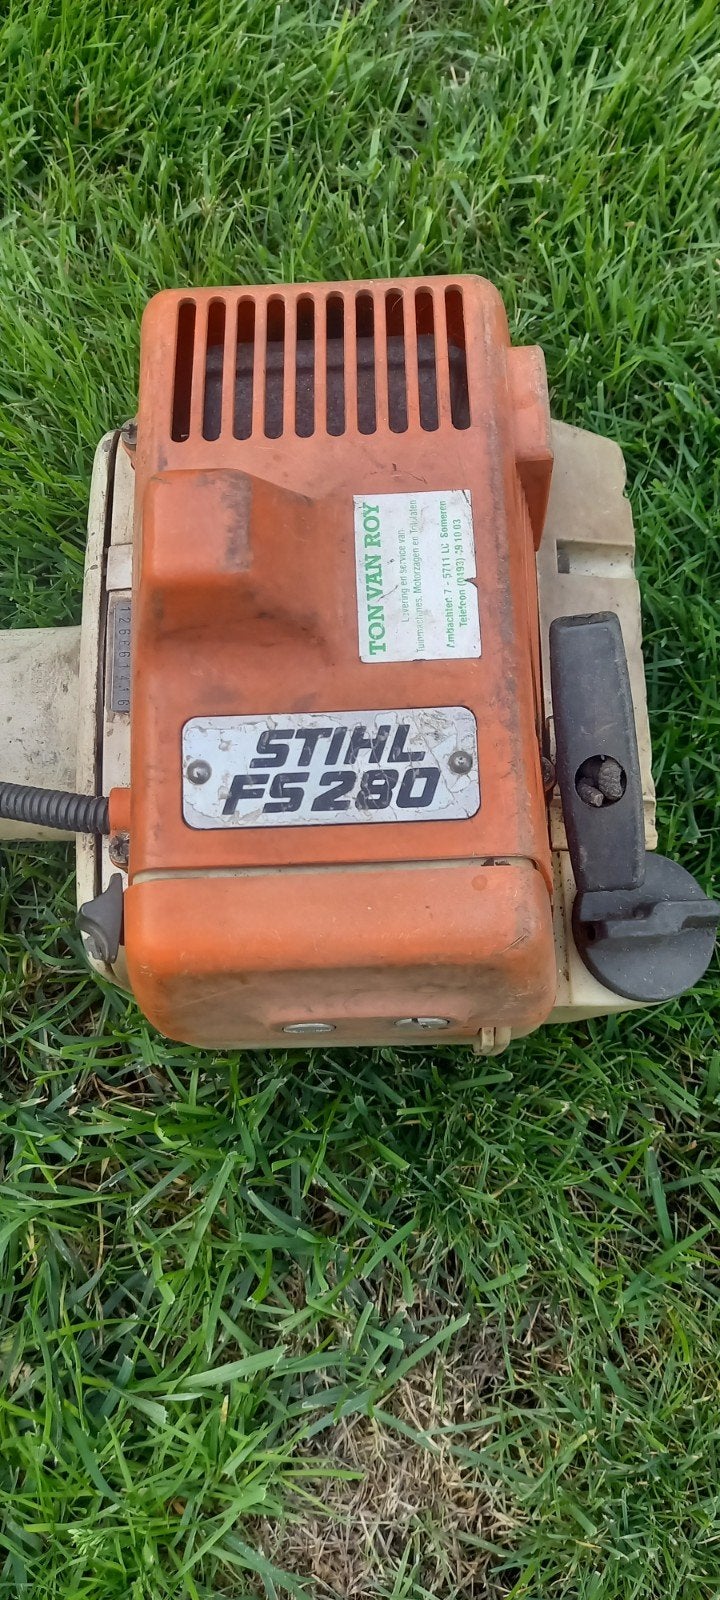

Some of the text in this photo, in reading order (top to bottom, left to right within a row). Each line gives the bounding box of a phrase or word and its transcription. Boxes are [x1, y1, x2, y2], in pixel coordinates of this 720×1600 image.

[439, 500, 449, 538] Someren
[452, 519, 461, 530] 03
[453, 531, 462, 543] 10
[412, 536, 420, 546] en
[362, 502, 387, 655] TON VAN ROY
[412, 547, 423, 594] Motorzagen
[441, 556, 453, 579] 5711
[458, 589, 468, 628] Telefoon
[249, 724, 426, 769] STIHL
[221, 767, 441, 815] FS 280
